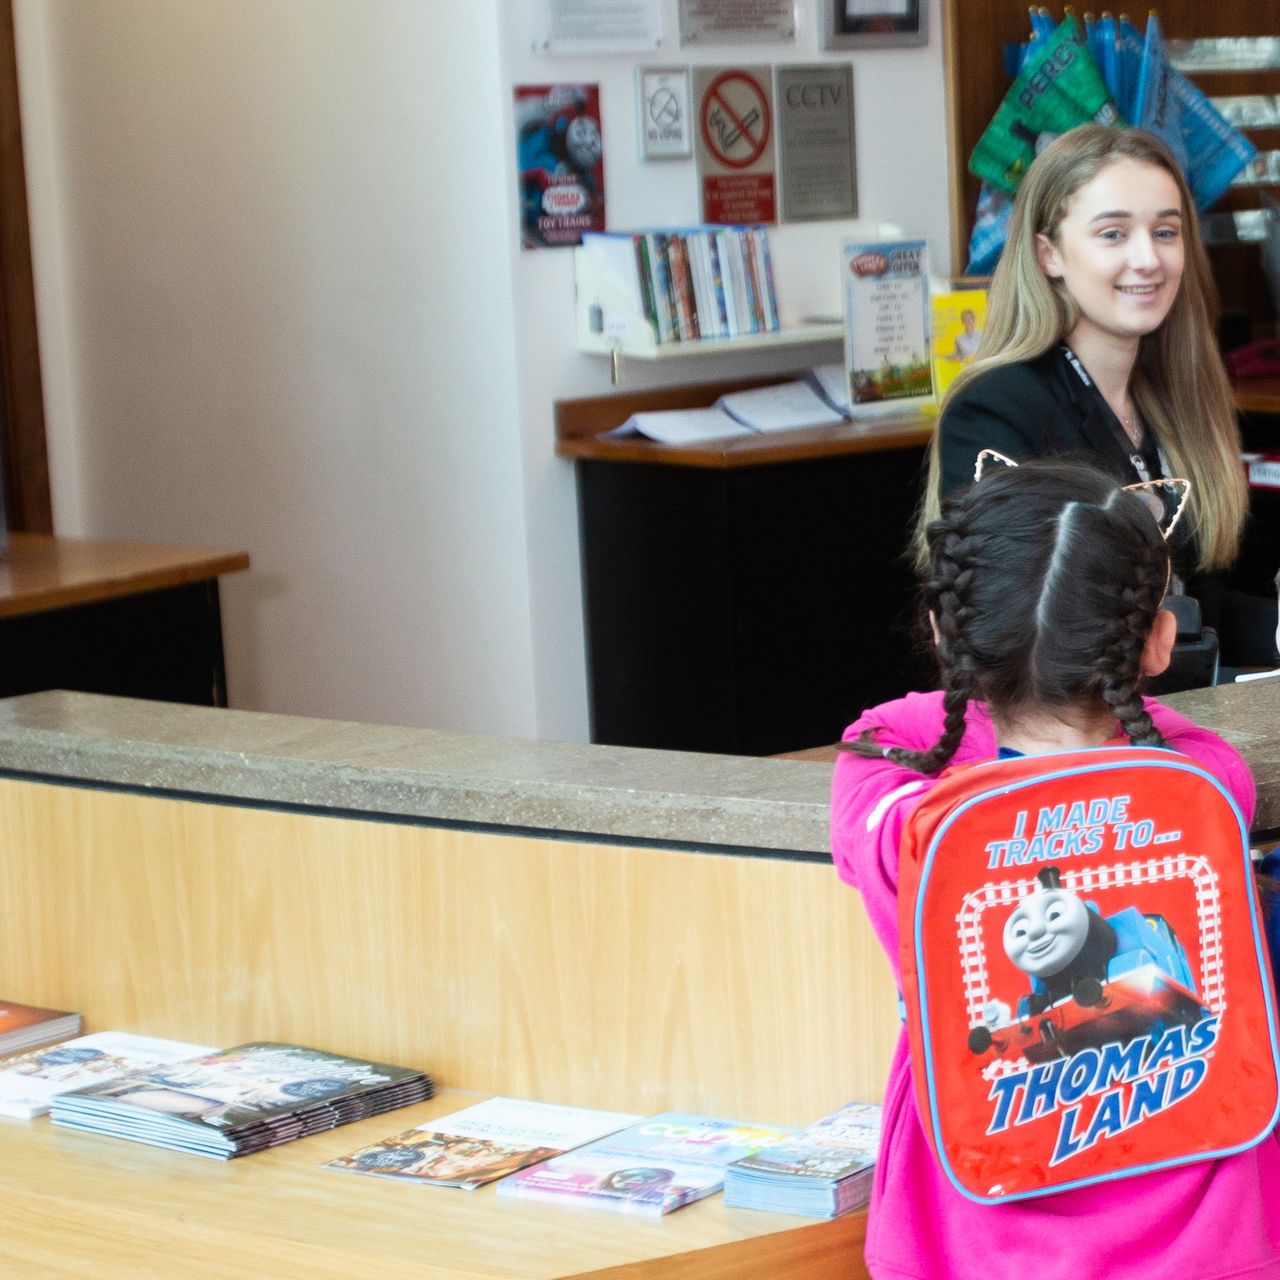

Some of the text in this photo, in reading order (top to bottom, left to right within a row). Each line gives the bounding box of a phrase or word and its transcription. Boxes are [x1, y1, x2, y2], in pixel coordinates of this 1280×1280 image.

[785, 82, 842, 109] CCTV
[538, 215, 591, 231] TOY TRAINS
[890, 249, 922, 262] GREAT
[892, 261, 920, 273] OFFER
[1013, 795, 1130, 839] I MADE
[984, 819, 1181, 869] TRACKS TO...
[985, 1016, 1222, 1136] THOMAS
[1048, 1057, 1208, 1167] LAND
